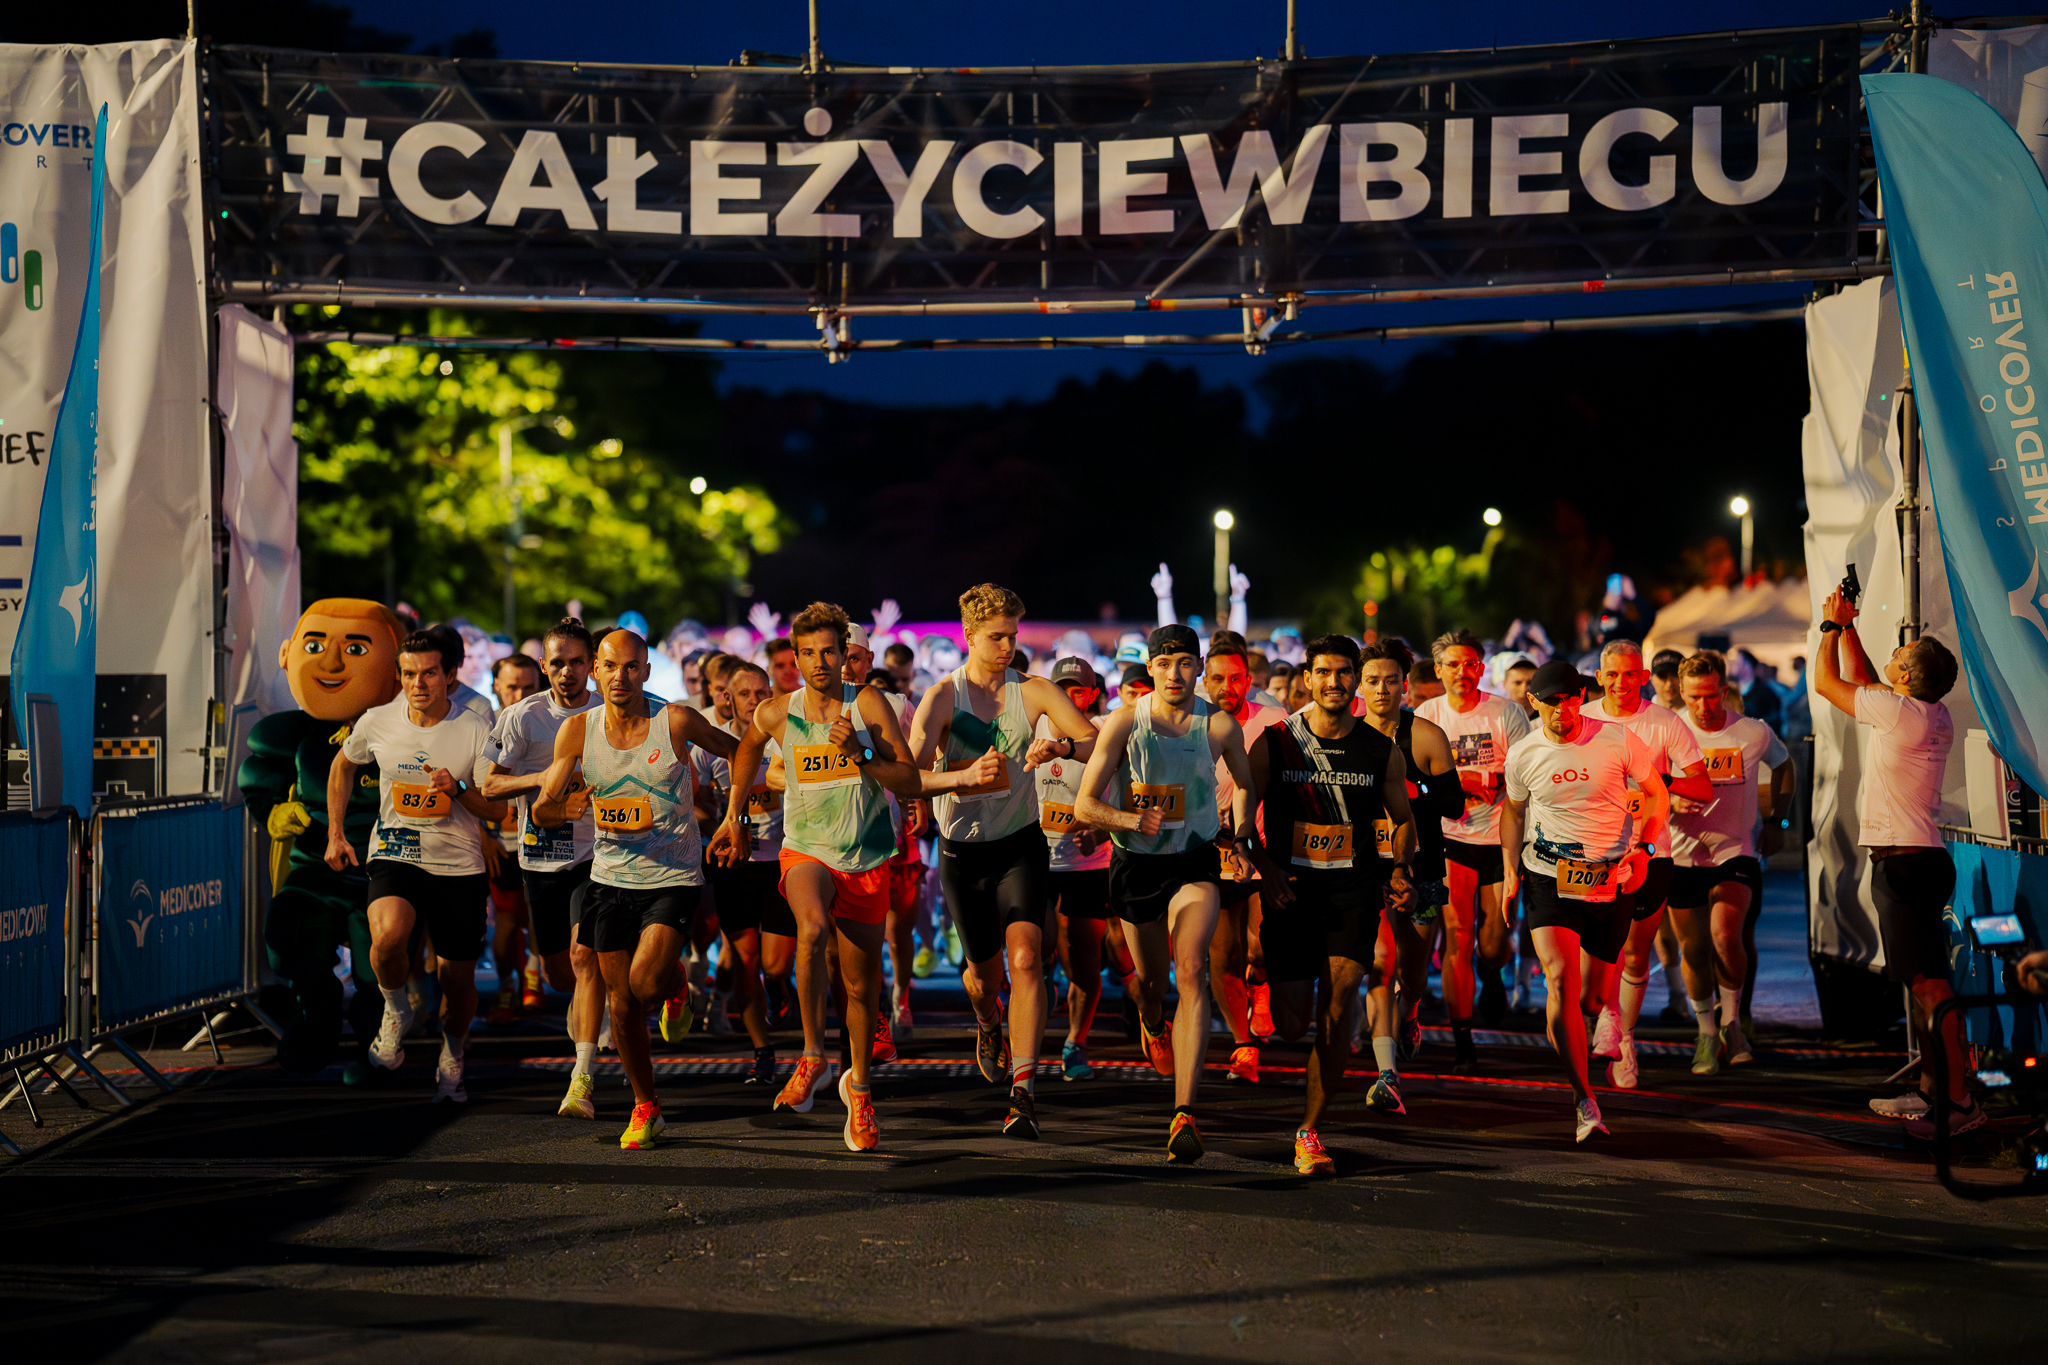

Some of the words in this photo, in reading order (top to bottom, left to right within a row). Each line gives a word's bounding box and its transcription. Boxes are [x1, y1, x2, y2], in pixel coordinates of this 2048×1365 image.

[0, 122, 93, 149] OVER
[282, 102, 1789, 239] #CAŁEŻYCIEWBIEGU
[803, 754, 848, 772] 251/3
[1042, 778, 1070, 789] GASPOL
[1282, 769, 1374, 787] RUNMAGEDDON
[402, 793, 438, 810] 83/5
[1132, 793, 1176, 812] 251/1
[600, 807, 642, 825] 256/1
[1302, 832, 1346, 853] 189/2
[1567, 870, 1610, 887] 120/2
[160, 878, 222, 917] MEDICOVER
